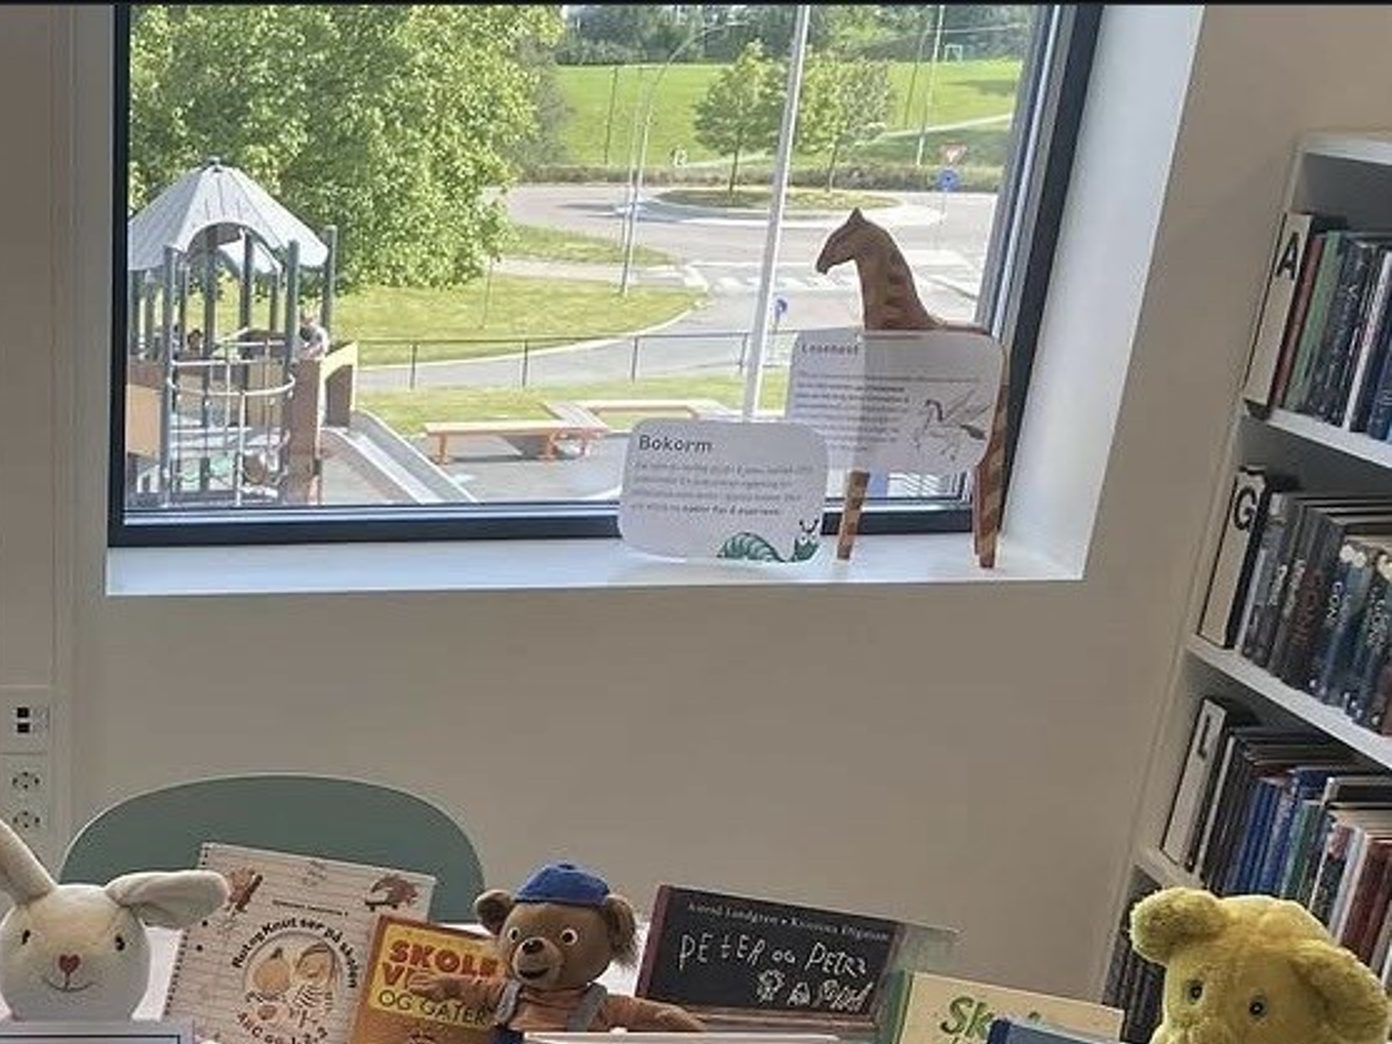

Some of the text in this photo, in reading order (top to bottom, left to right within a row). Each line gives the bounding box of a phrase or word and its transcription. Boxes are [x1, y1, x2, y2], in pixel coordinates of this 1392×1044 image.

[1275, 231, 1300, 281] A
[638, 434, 712, 452] Bokorm
[1233, 486, 1258, 532] G
[379, 990, 412, 1011] OG
